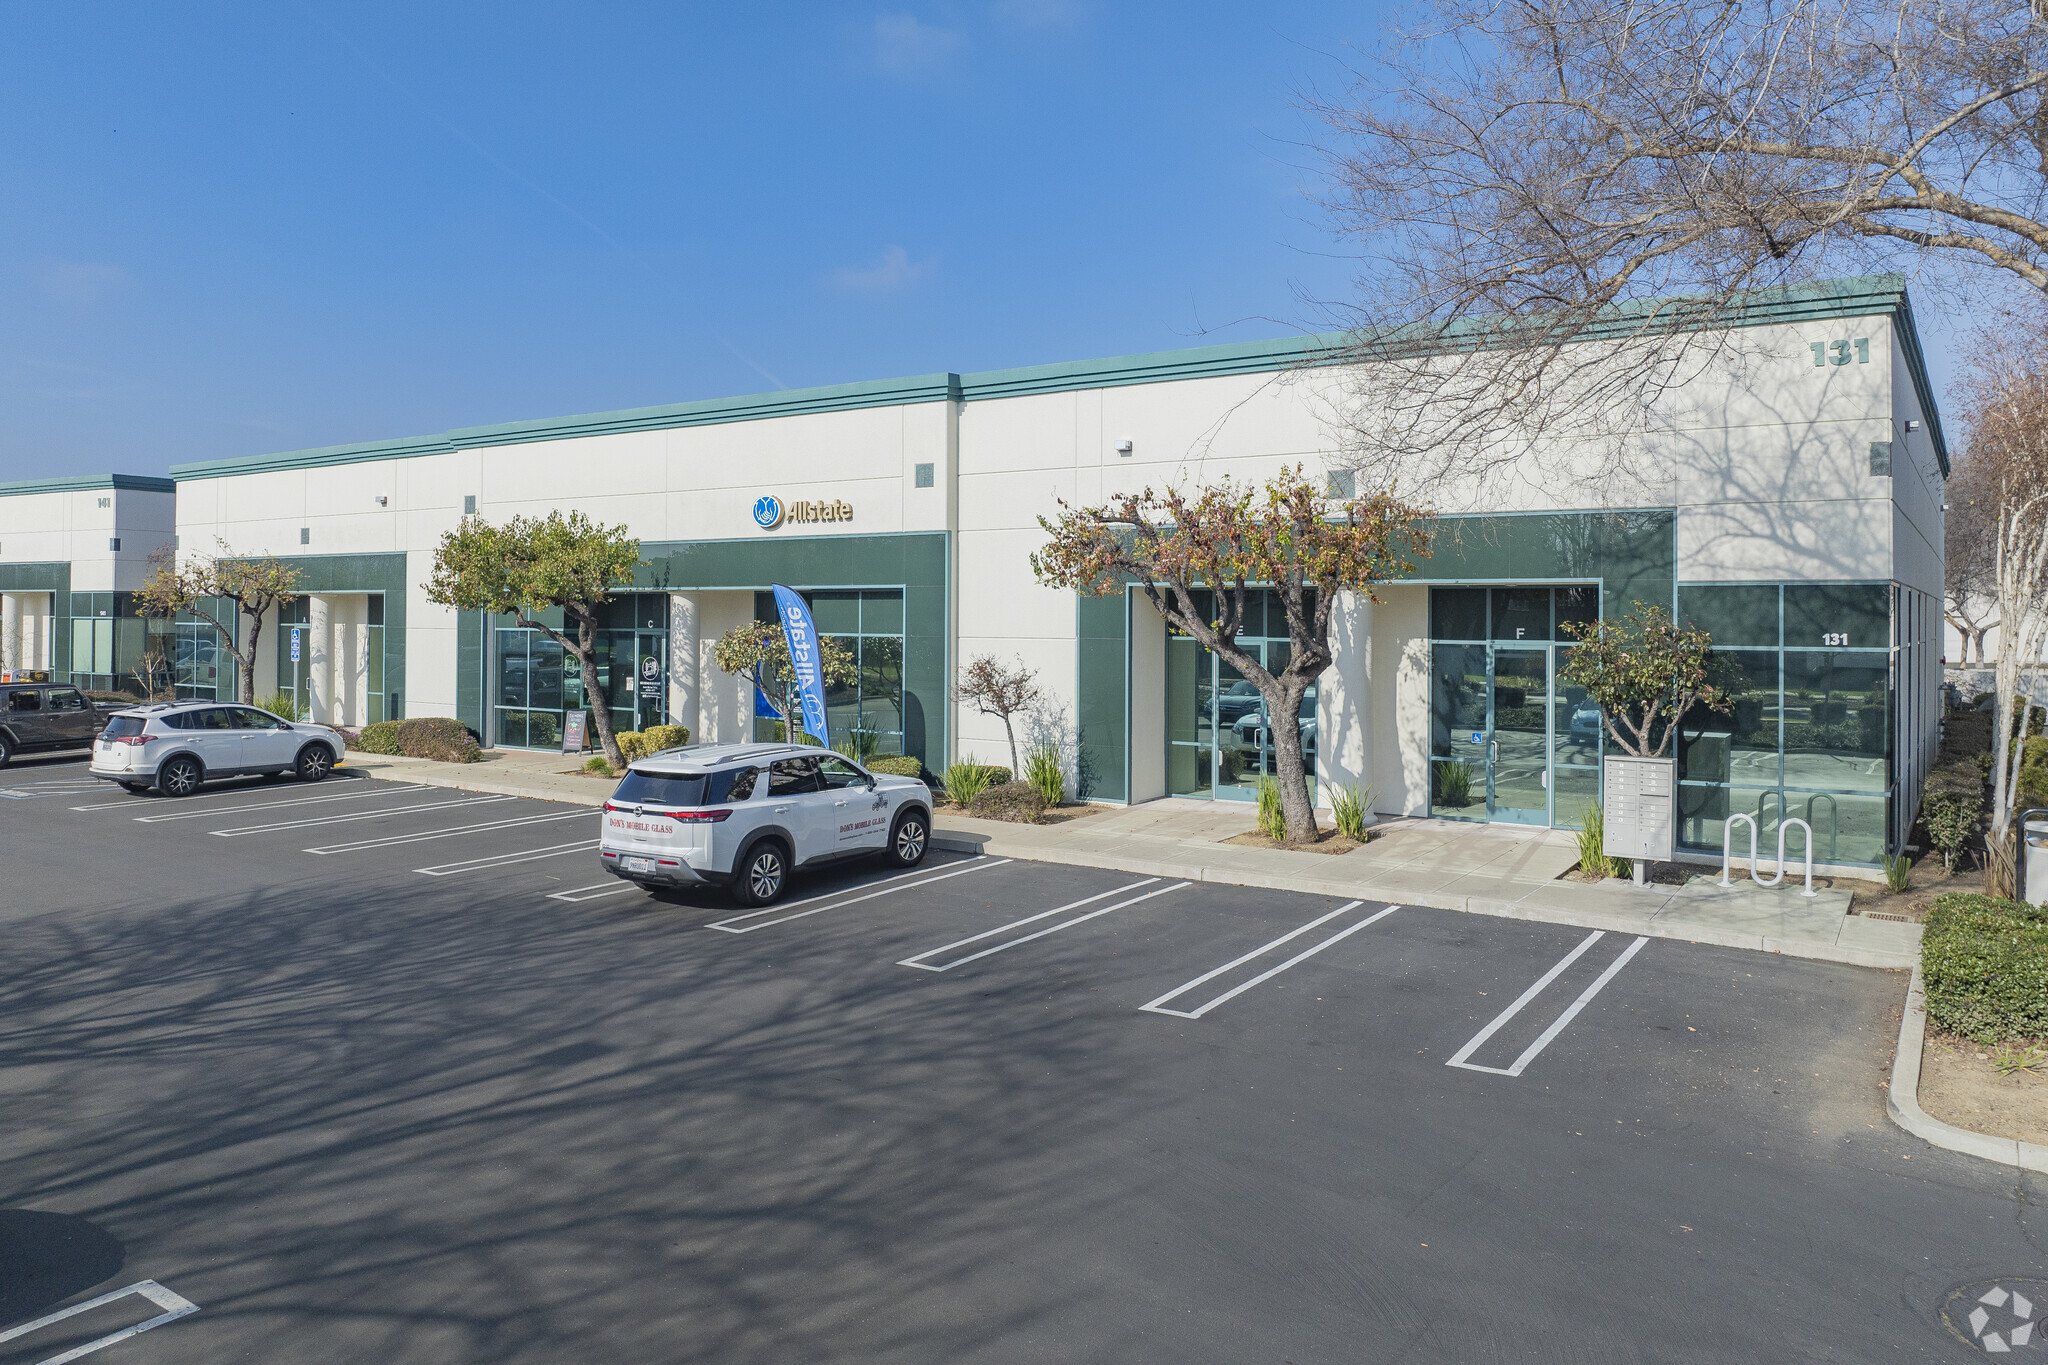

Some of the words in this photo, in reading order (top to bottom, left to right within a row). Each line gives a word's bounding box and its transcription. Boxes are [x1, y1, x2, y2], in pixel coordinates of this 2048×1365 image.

[1810, 338, 1869, 367] 131
[98, 498, 110, 508] 141
[786, 499, 852, 521] Allstate
[648, 620, 653, 628] C
[1516, 628, 1525, 639] F
[1822, 633, 1848, 645] 131
[609, 818, 625, 828] DON'S
[626, 821, 649, 831] MOBILE
[651, 824, 673, 833] GLASS
